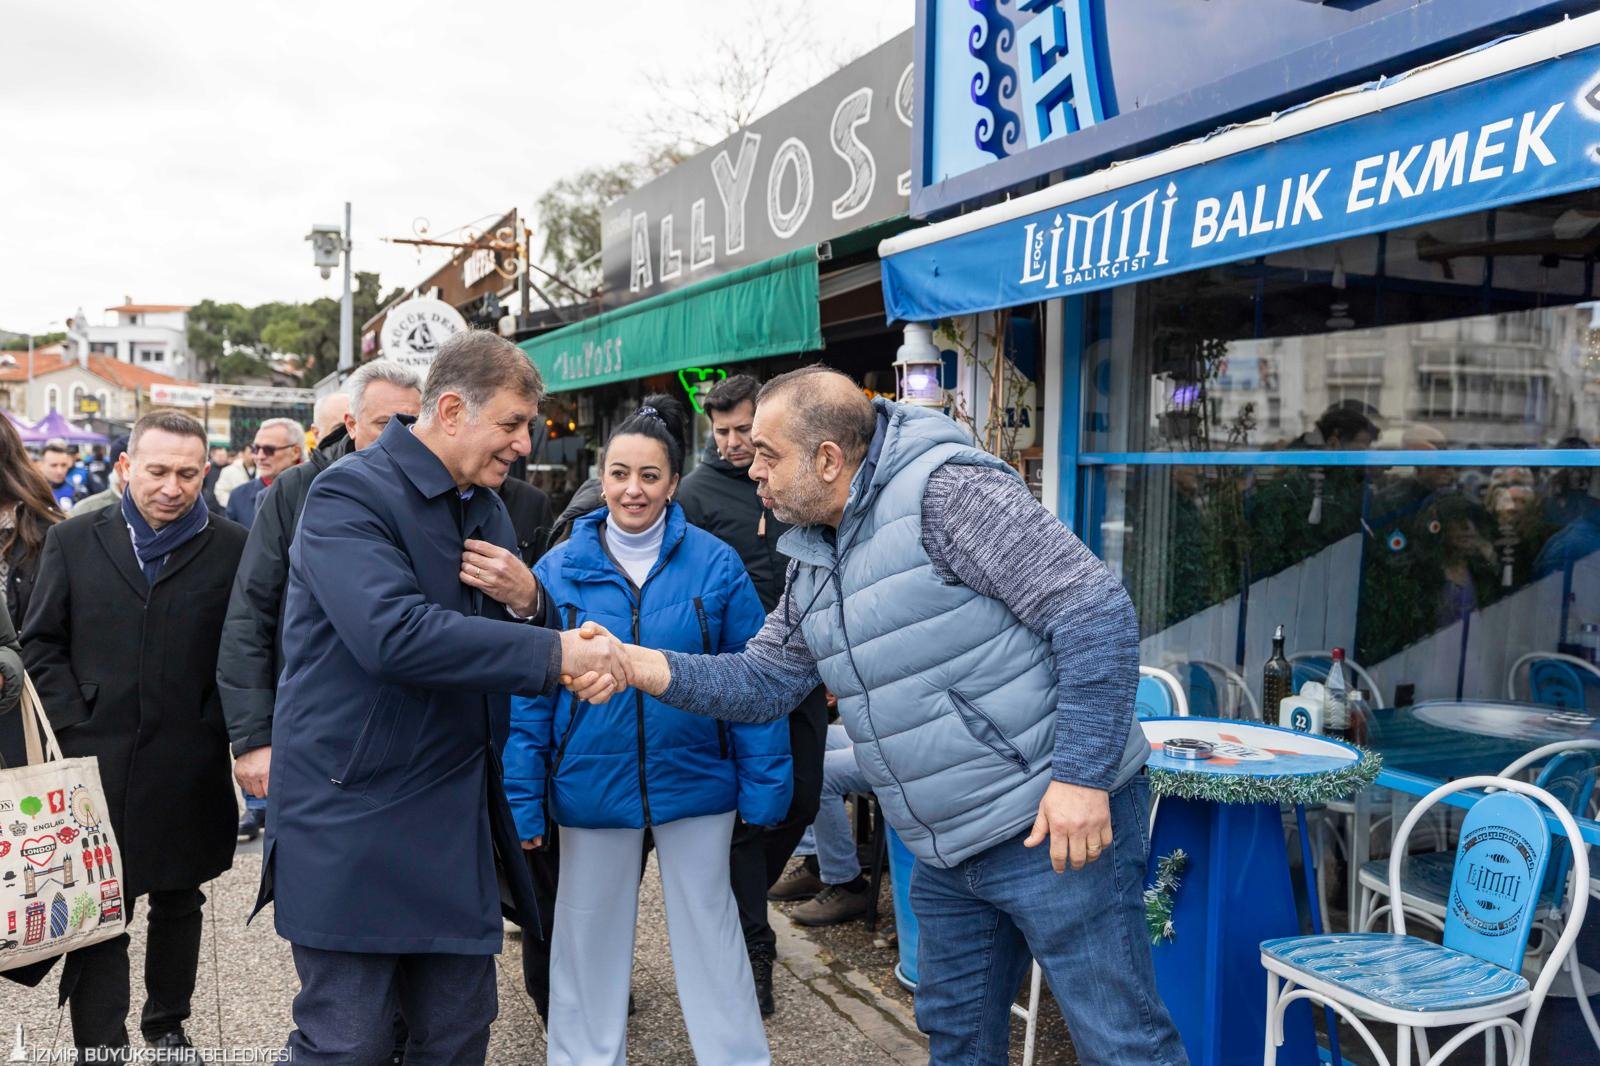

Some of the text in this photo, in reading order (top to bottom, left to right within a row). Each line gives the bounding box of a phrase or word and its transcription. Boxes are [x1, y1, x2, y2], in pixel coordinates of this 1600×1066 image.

[1191, 102, 1566, 249] BALIK EKMEK
[1295, 715, 1307, 728] 22
[33, 819, 65, 832] ENGLAND
[23, 844, 56, 856] LONDON
